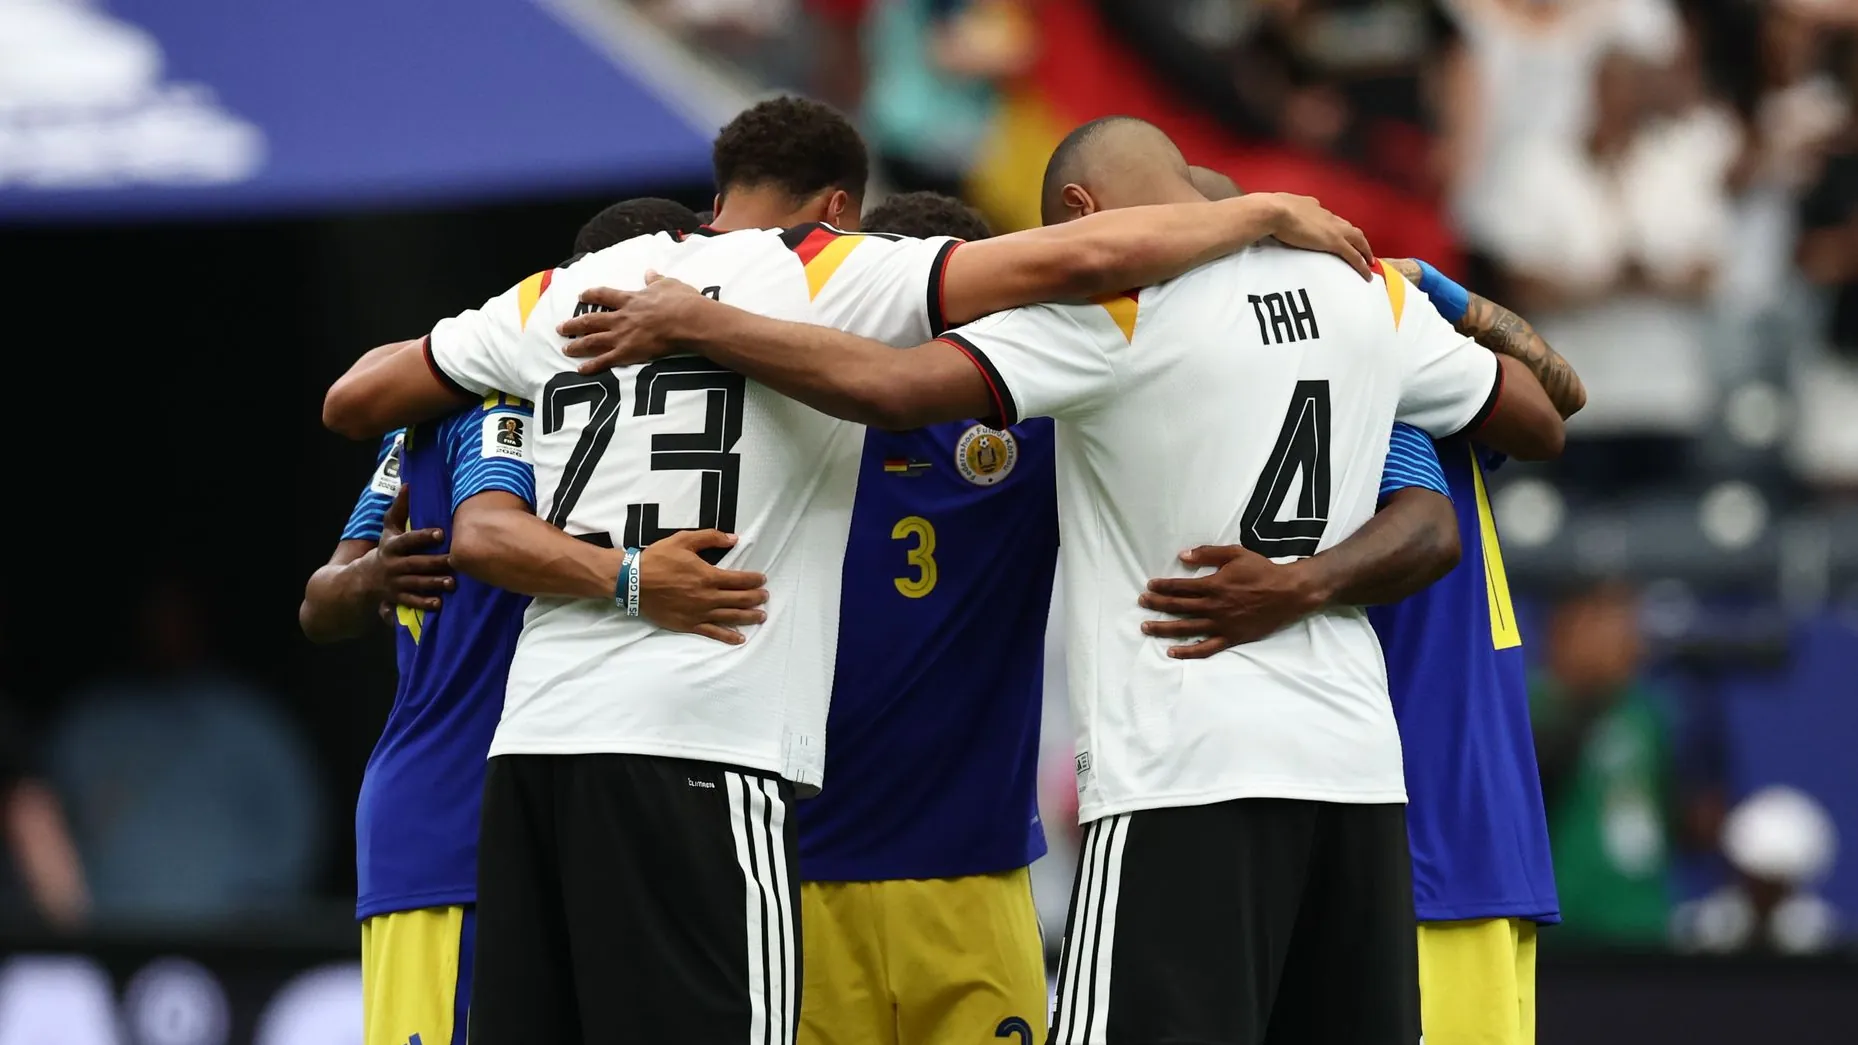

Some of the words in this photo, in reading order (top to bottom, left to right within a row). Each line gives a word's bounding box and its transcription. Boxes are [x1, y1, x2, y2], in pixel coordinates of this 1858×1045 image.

[1248, 288, 1320, 345] TAH
[495, 447, 523, 458] 2026
[540, 356, 746, 565] 23
[1240, 379, 1331, 561] 4
[630, 567, 638, 592] GOD
[891, 515, 938, 599] 3
[630, 594, 638, 605] IN
